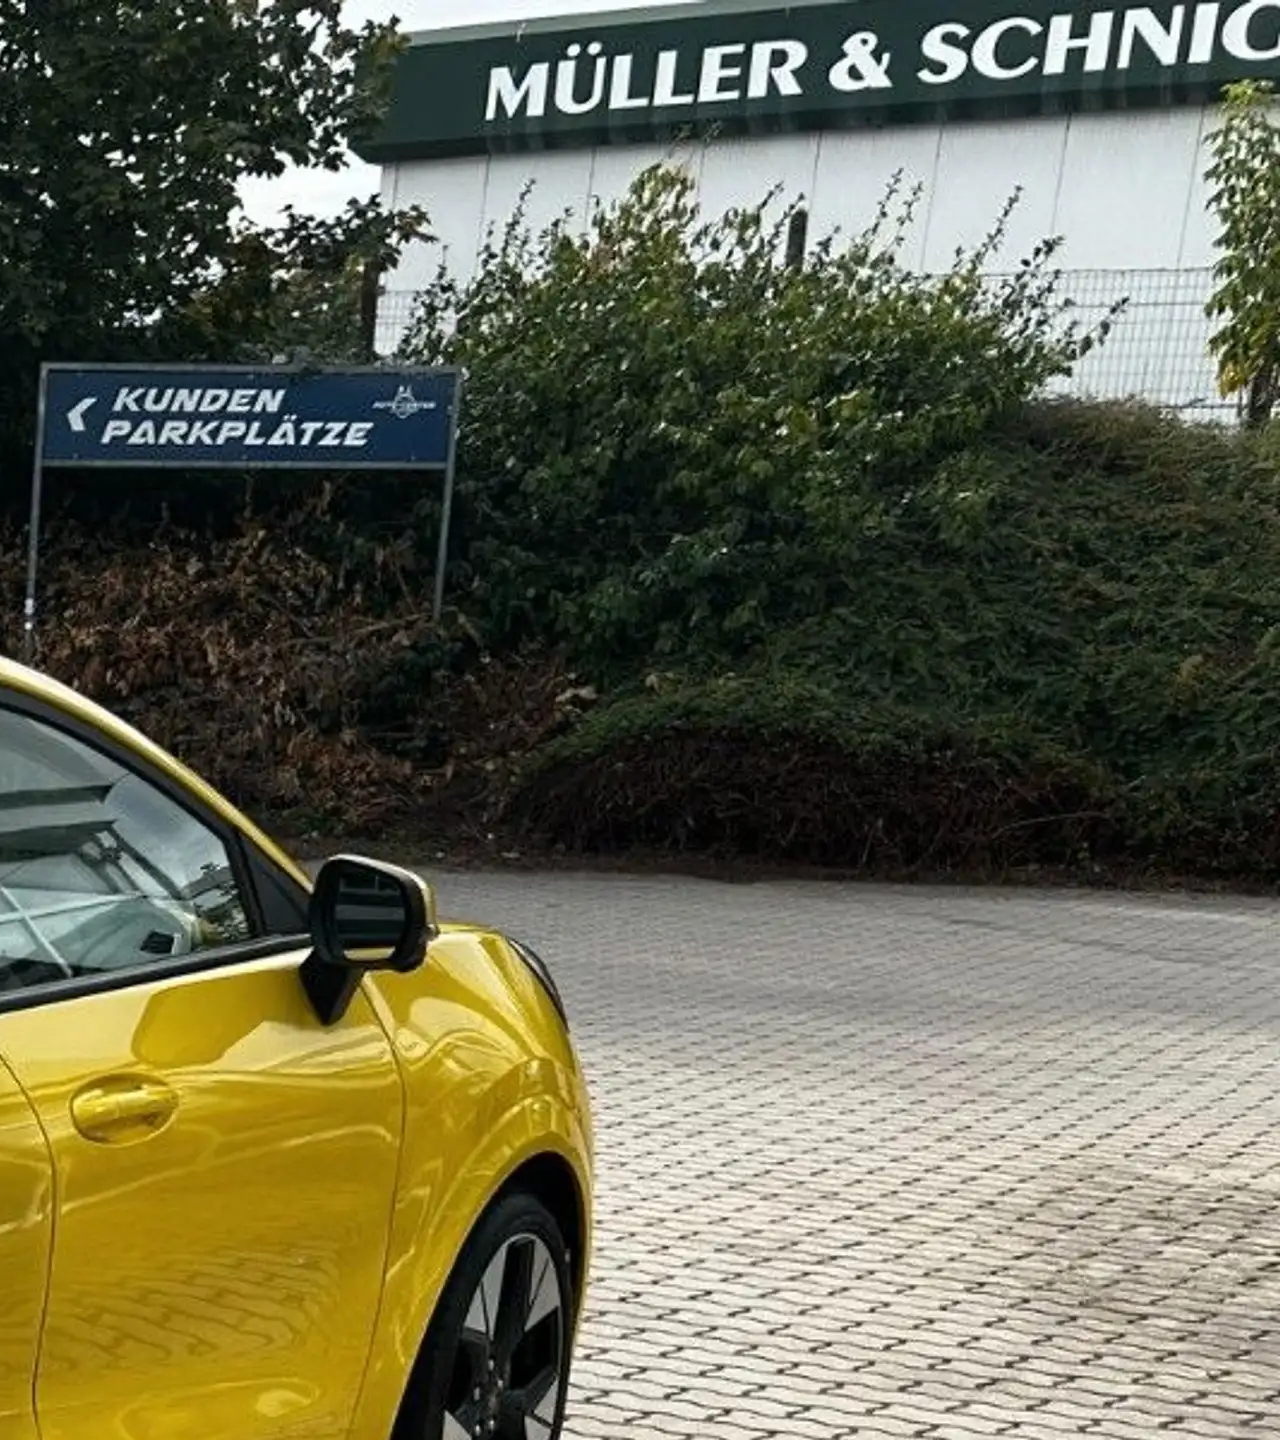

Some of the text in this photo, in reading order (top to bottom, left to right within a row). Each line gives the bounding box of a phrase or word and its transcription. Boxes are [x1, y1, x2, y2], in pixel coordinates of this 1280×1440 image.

[485, 39, 808, 121] MÜLLER
[829, 31, 892, 91] &
[113, 387, 286, 413] KUNDEN
[101, 415, 375, 447] PARKPLÄTZE
